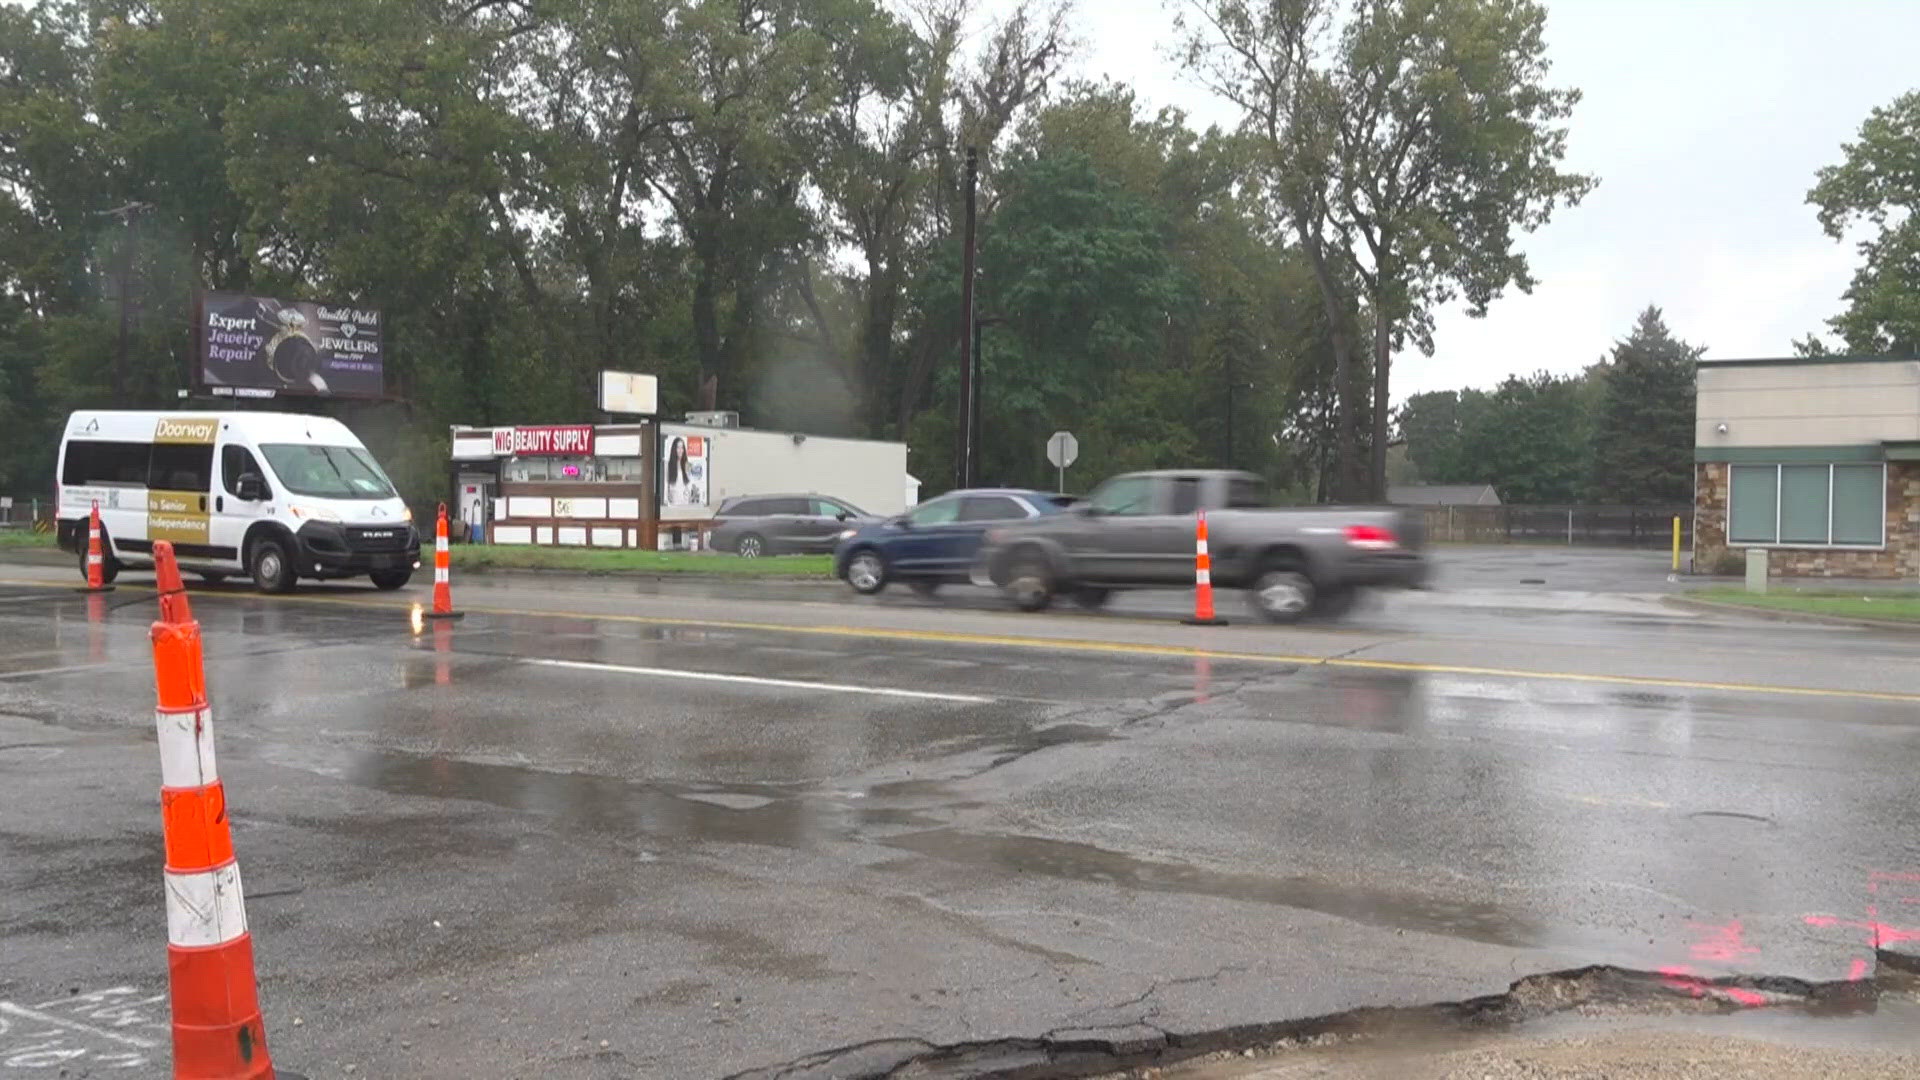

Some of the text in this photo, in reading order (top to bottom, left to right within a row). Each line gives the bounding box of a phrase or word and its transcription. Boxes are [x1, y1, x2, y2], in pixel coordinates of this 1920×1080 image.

[208, 312, 256, 331] Expert
[208, 329, 263, 350] Jewelry
[319, 336, 378, 353] JEWELERS
[208, 344, 256, 362] Repair
[157, 419, 213, 441] Doorway
[494, 432, 512, 451] WIG
[515, 429, 589, 451] BEAUTY SUPPLY
[160, 500, 187, 511] Senior
[149, 515, 206, 531] Independence
